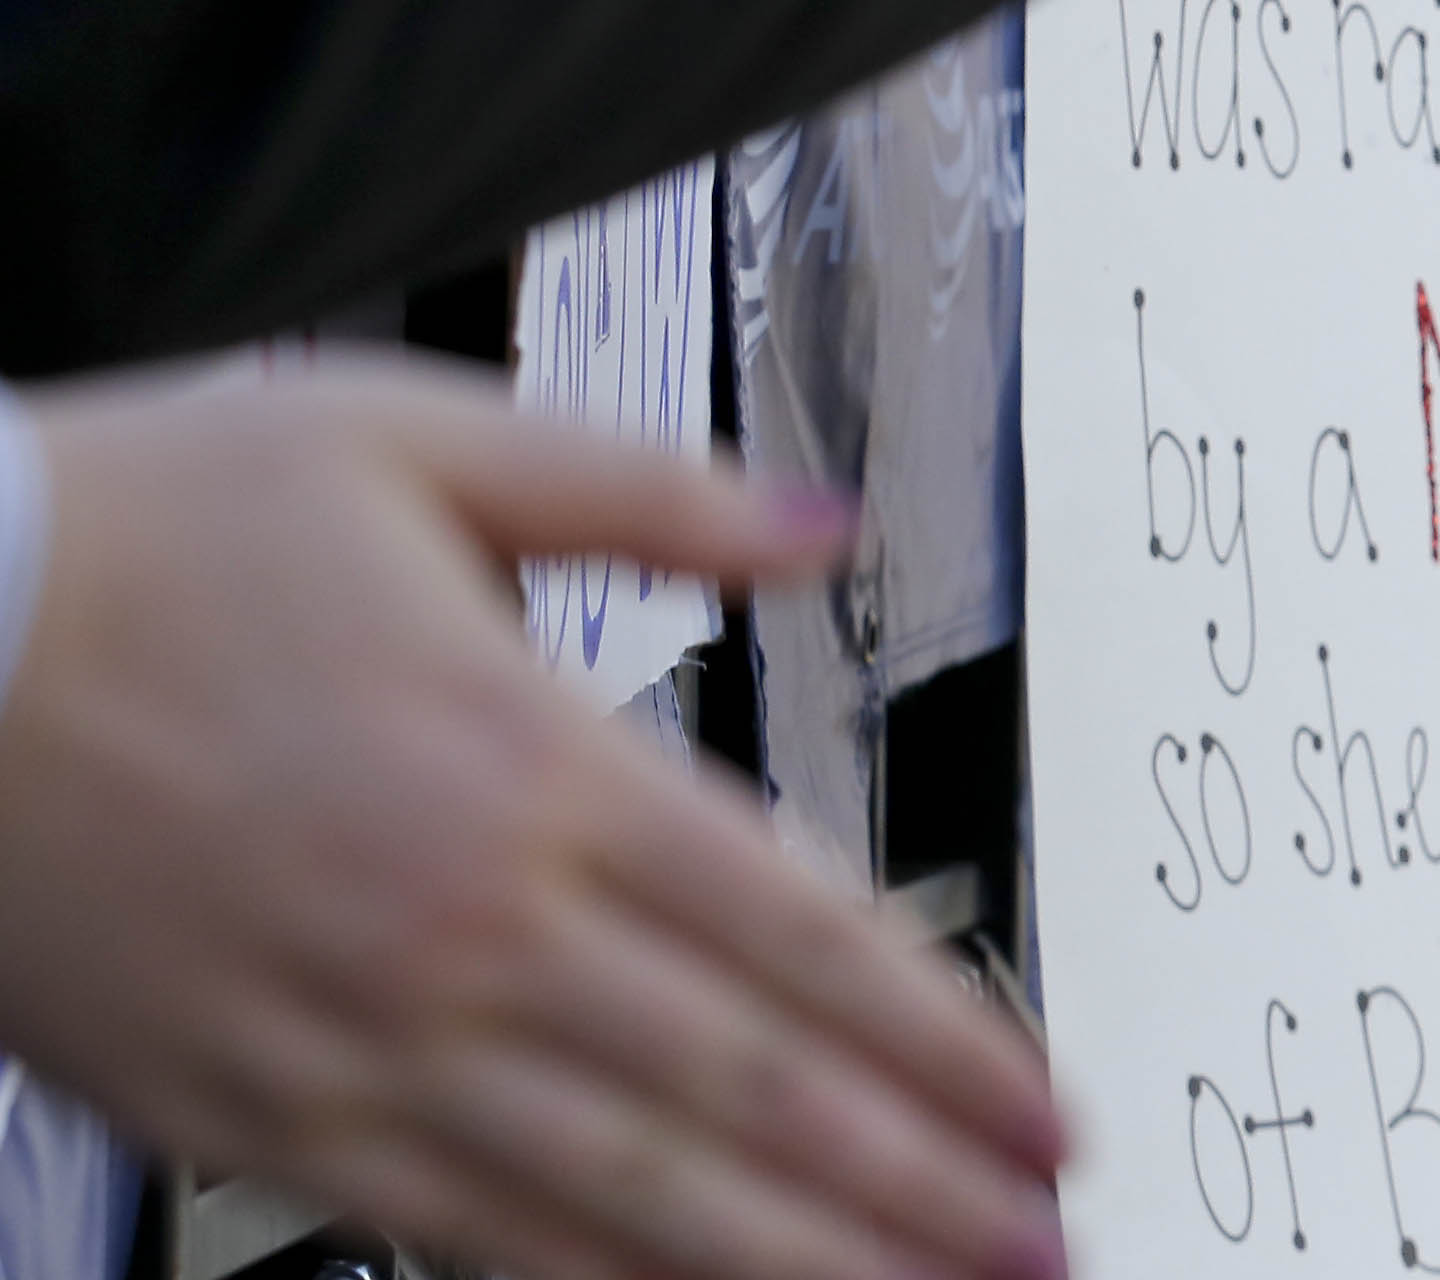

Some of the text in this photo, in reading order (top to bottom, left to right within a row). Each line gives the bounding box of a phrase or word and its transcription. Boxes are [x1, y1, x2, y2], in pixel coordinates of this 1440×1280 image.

[1132, 287, 1257, 696] by
[1308, 426, 1378, 563] a
[1152, 732, 1252, 912] so
[1187, 997, 1316, 1252] of
